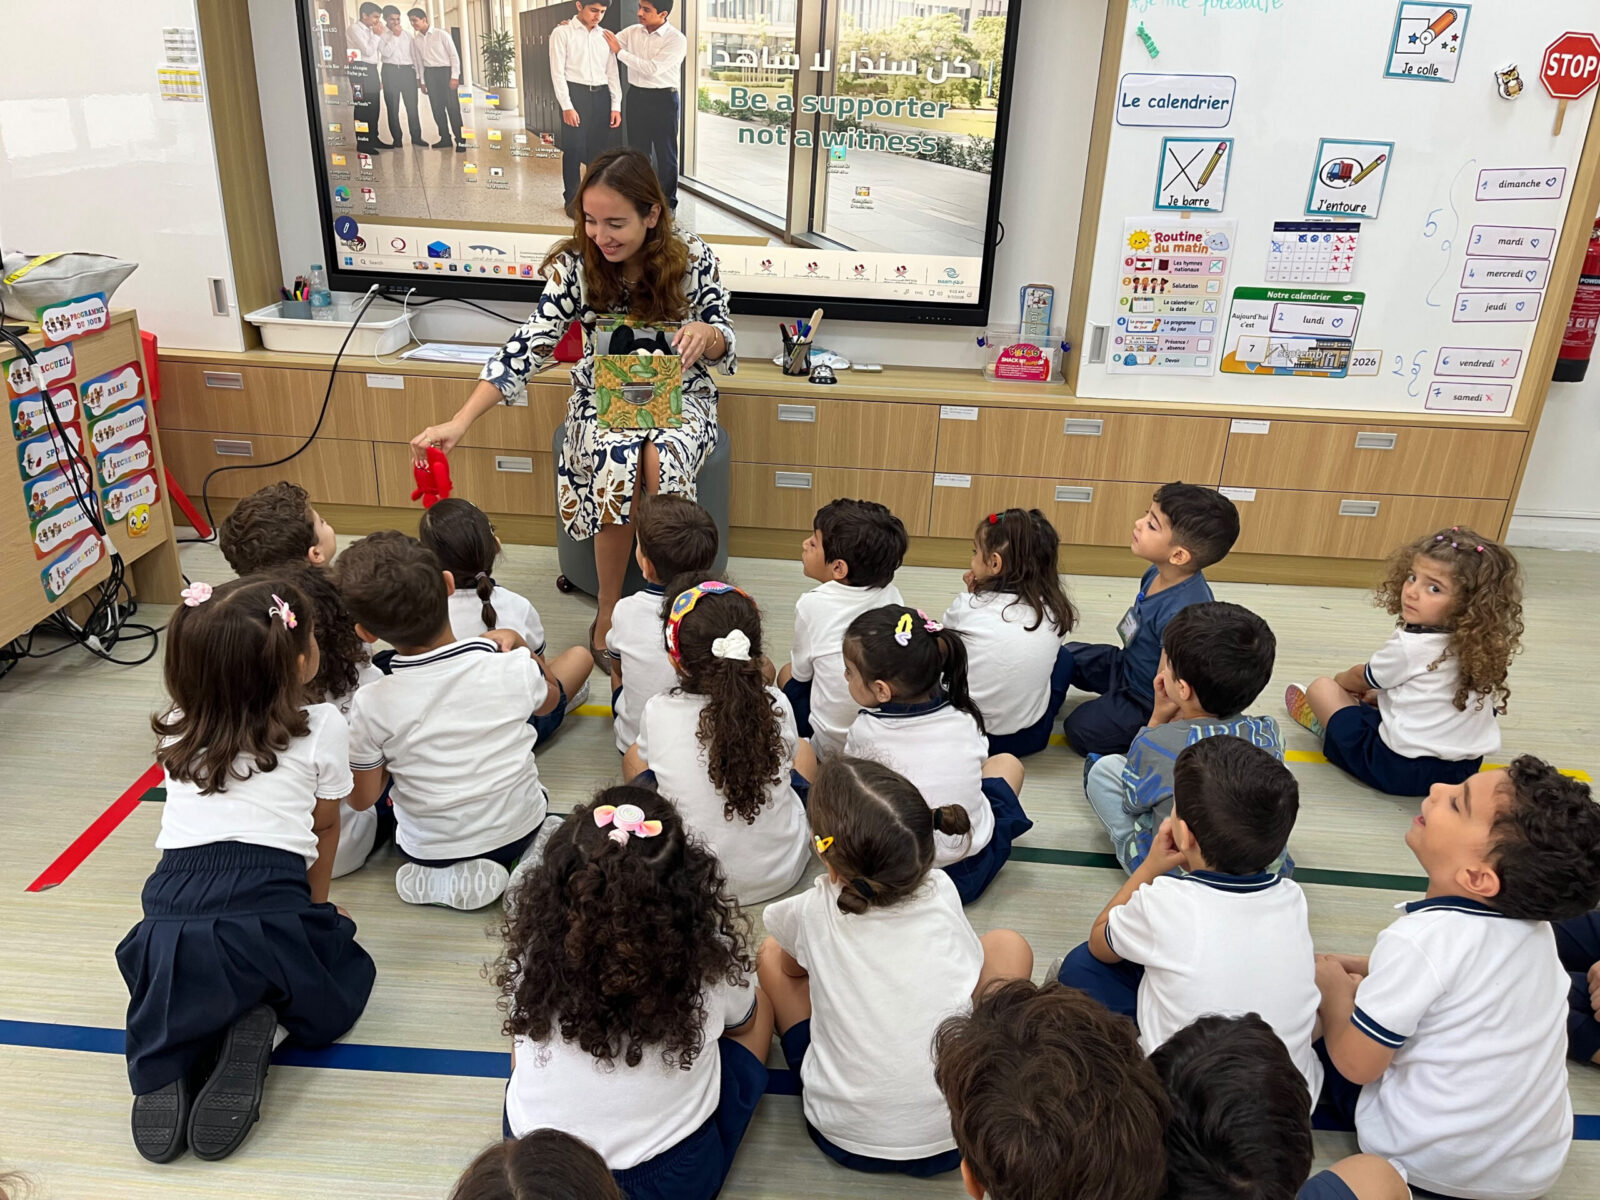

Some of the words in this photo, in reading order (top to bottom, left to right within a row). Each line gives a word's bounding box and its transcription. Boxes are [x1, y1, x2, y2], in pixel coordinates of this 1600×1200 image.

[809, 50, 831, 72] لا
[1547, 53, 1598, 78] STOP
[926, 53, 973, 84] كن
[1402, 63, 1413, 74] Je
[1417, 64, 1439, 76] colle
[730, 87, 768, 111] Be
[777, 93, 795, 112] a
[802, 93, 951, 120] supporter
[1122, 92, 1141, 108] Le
[1147, 93, 1229, 110] calendrier
[738, 125, 787, 147] not
[795, 129, 813, 148] a
[822, 127, 938, 154] witness
[1498, 179, 1541, 189] dimanche
[1167, 195, 1179, 207] Je
[1182, 195, 1210, 207] barre
[1317, 199, 1367, 213] J'entoure
[1423, 208, 1443, 238] 5
[1154, 230, 1203, 243] Routine
[1474, 234, 1482, 244] 3
[1498, 237, 1524, 246] mardi
[1153, 242, 1170, 254] du
[1172, 242, 1209, 254] matin
[1468, 268, 1475, 278] 4
[1486, 269, 1524, 278] mercredi
[1267, 291, 1290, 299] Notre
[1290, 291, 1332, 301] calendrier
[1460, 299, 1469, 311] 5
[1484, 302, 1507, 313] jeudi
[70, 306, 105, 321] PROGRAMME
[1231, 312, 1269, 321] Aujourd'hui
[1278, 312, 1284, 321] 2
[76, 320, 86, 329] DU
[1303, 315, 1325, 325] lundi
[1249, 344, 1256, 353] 7
[1278, 347, 1334, 360] septembre
[40, 356, 71, 374] ACCUEIL
[1352, 357, 1377, 366] 2026
[1442, 355, 1450, 366] 6
[1459, 359, 1495, 368] vendredi
[1432, 387, 1442, 398] 7
[1453, 393, 1483, 402] samedi
[115, 415, 144, 433] COLLATION
[124, 485, 150, 503] ATELIER
[62, 512, 86, 529] COLLAT
